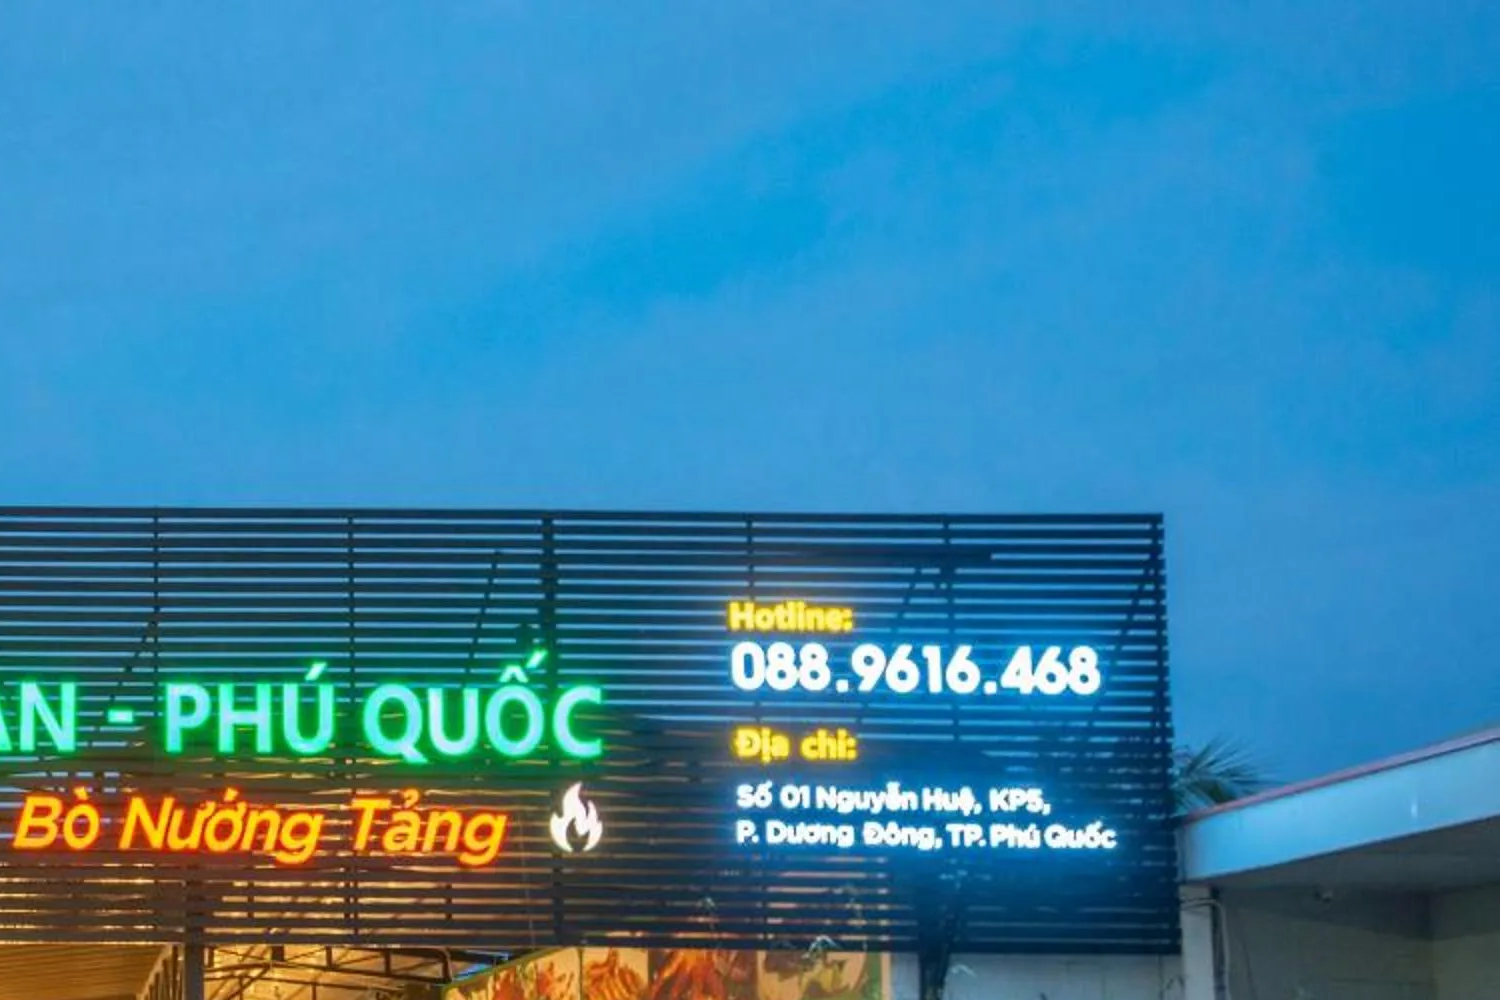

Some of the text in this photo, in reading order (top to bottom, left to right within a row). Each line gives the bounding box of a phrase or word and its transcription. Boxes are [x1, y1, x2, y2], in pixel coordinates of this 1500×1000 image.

[729, 599, 853, 632] Hotline:
[730, 641, 1101, 695] 088.9616.468
[108, 710, 133, 723] -
[165, 662, 334, 755] PHÚ
[362, 650, 604, 763] QUỐC
[733, 727, 791, 763] Địa
[736, 780, 773, 809] Số
[780, 785, 810, 809] 01
[989, 788, 1051, 815] KP5,
[13, 786, 101, 851] Bò
[119, 786, 323, 865] Nướng
[350, 788, 507, 866] Tảng
[736, 819, 760, 844] P.
[1044, 820, 1118, 849] Quốc
